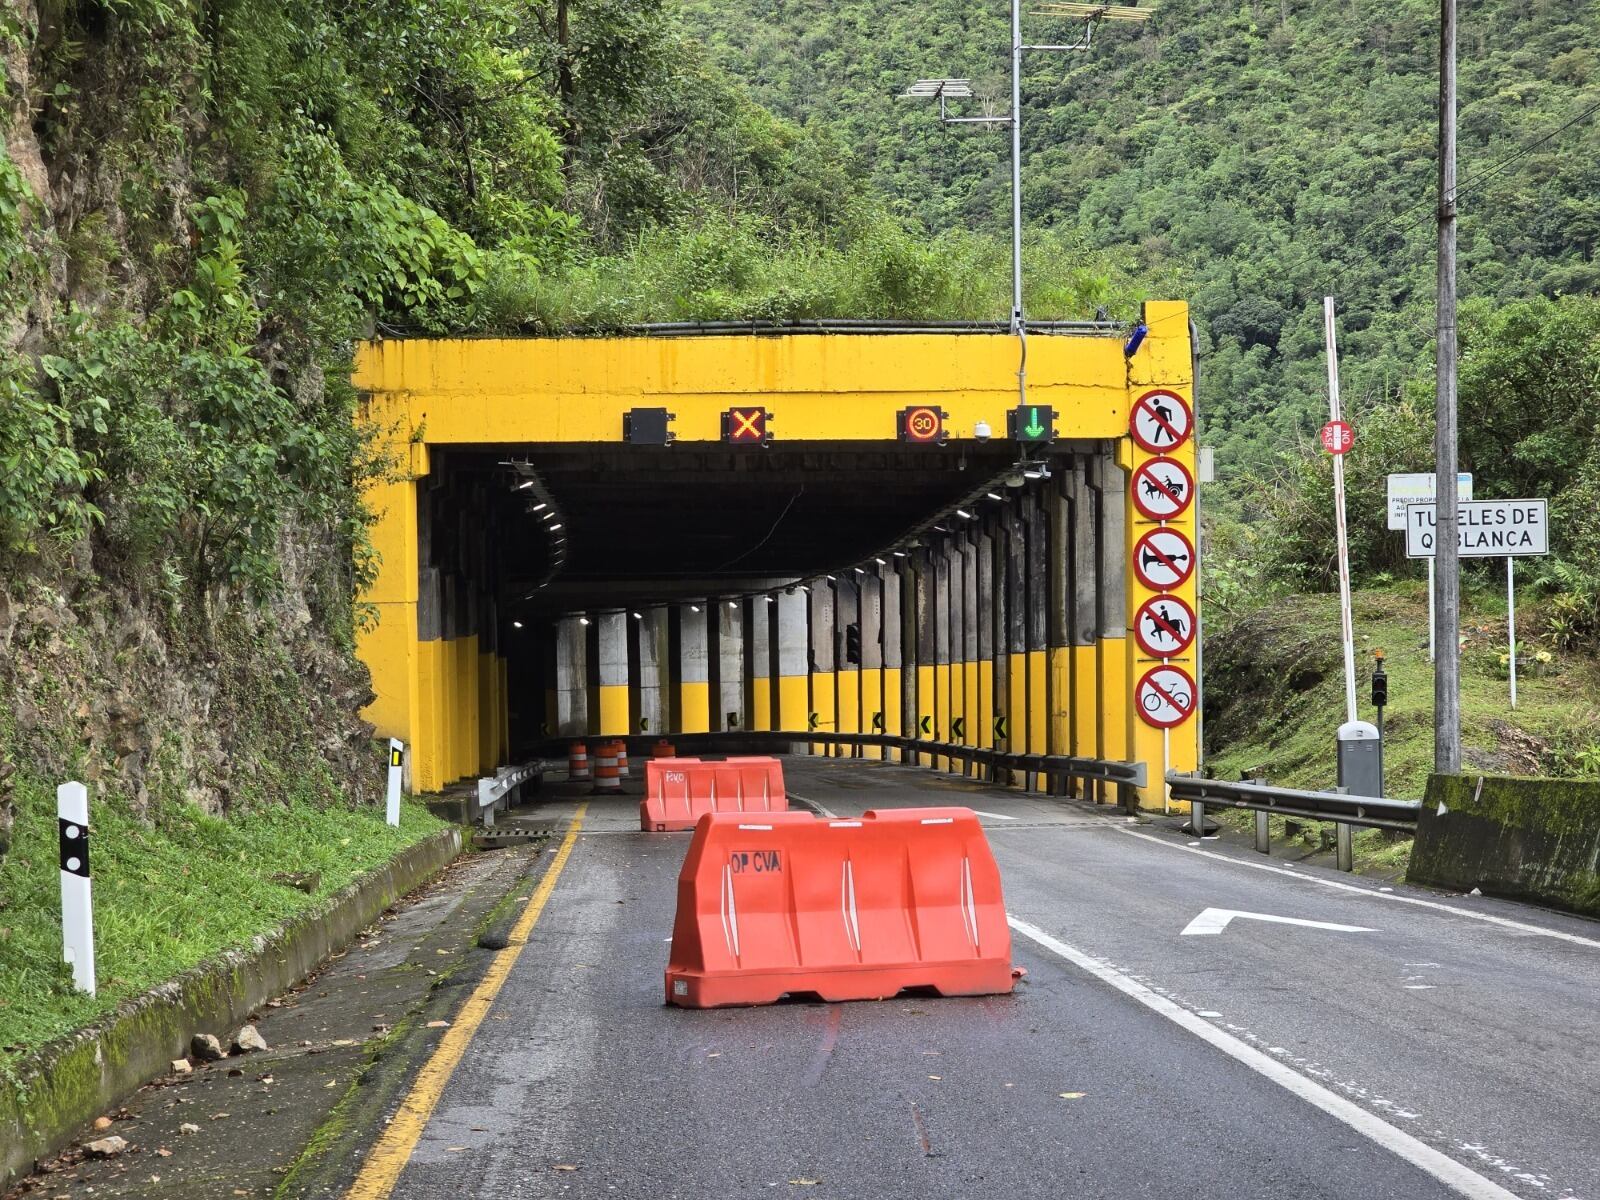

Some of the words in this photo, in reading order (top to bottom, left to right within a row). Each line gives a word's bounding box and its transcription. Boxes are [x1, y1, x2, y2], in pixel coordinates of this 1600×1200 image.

[914, 417, 932, 430] 30
[1324, 426, 1333, 448] PASE
[1342, 430, 1351, 444] NO
[1414, 509, 1506, 527] TUELES
[1513, 508, 1539, 525] DE
